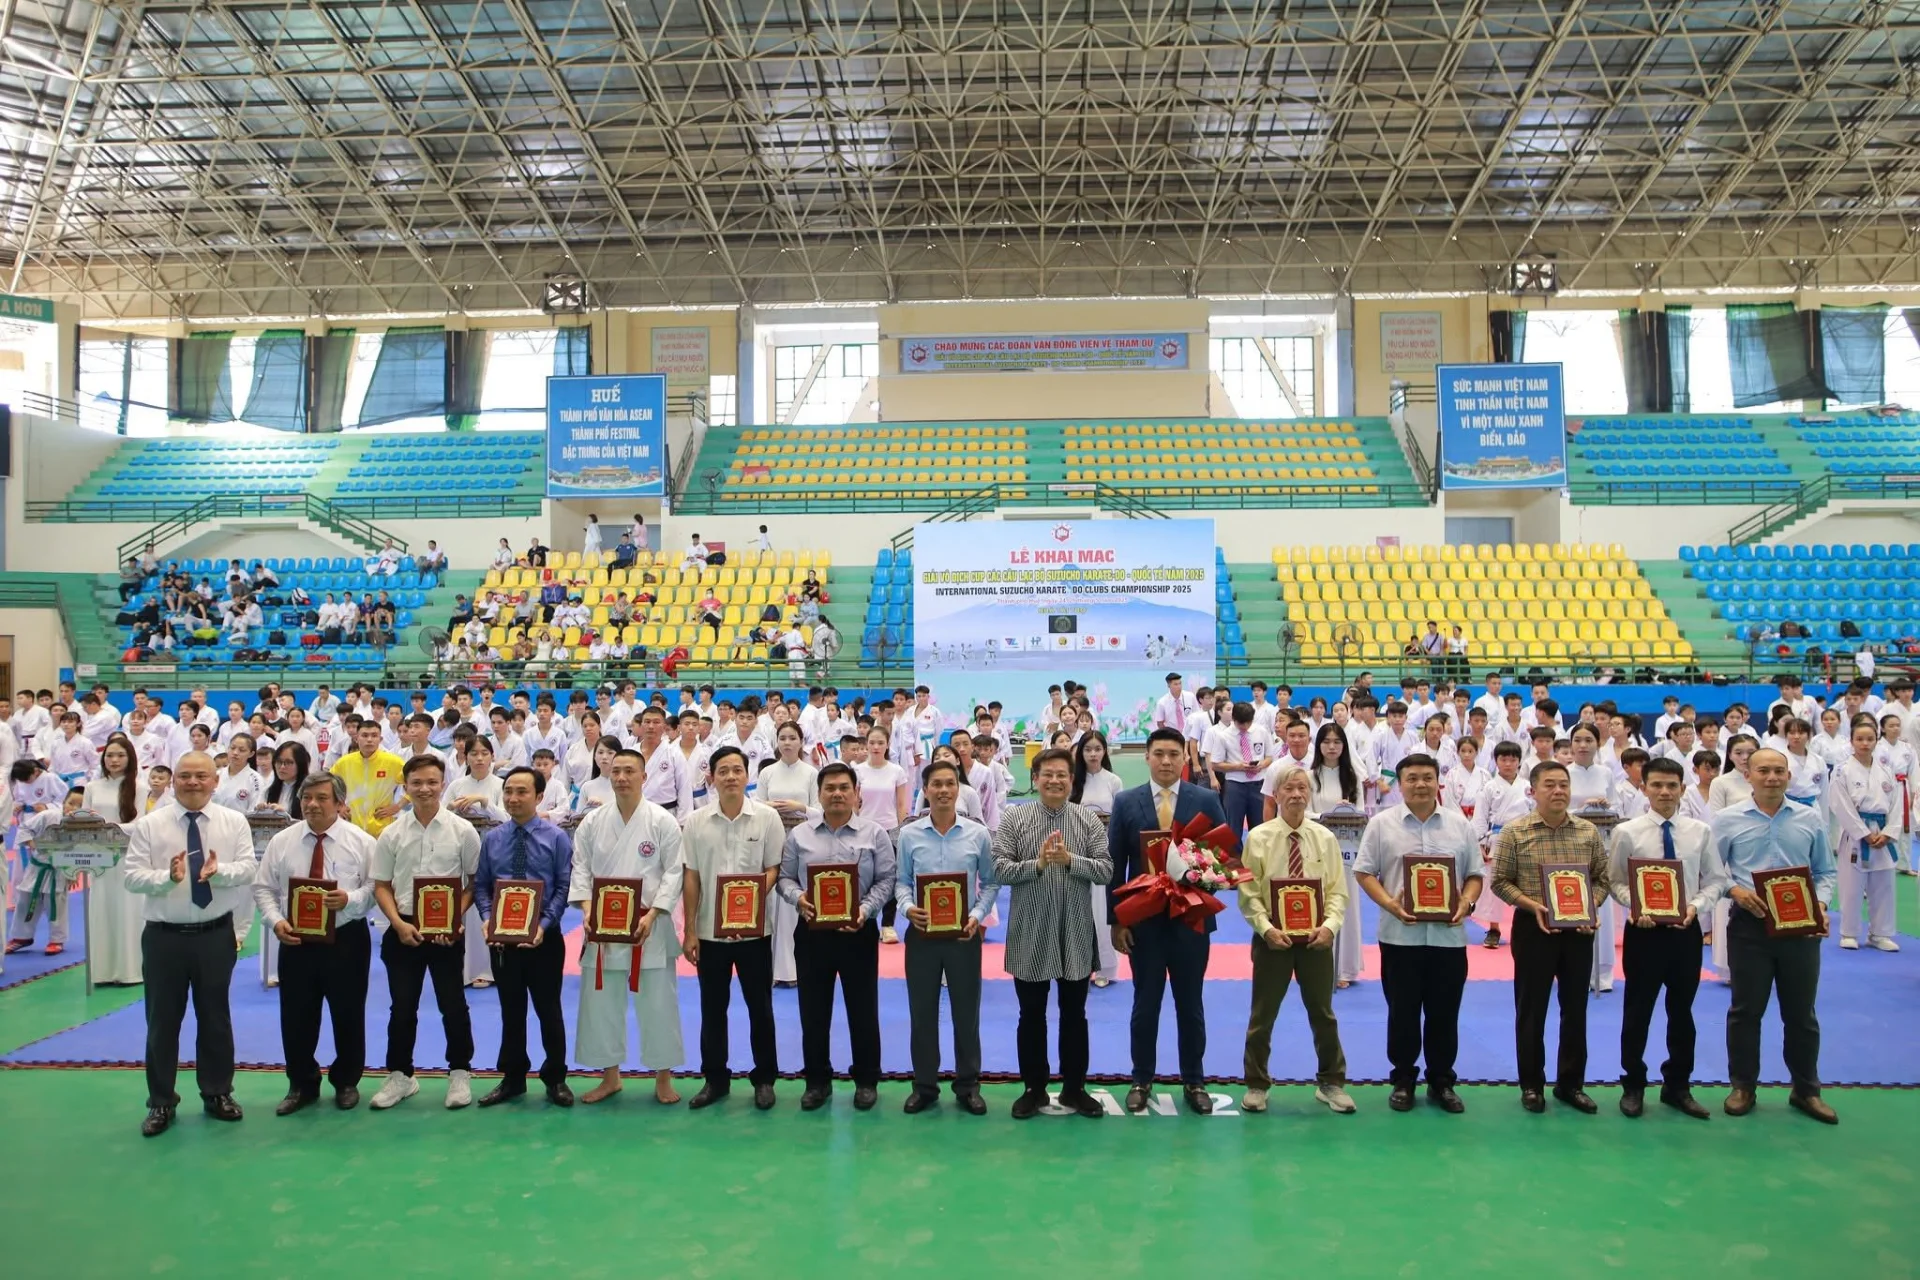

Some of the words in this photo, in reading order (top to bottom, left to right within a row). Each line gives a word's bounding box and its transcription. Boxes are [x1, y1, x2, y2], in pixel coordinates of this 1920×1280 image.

[591, 383, 620, 403] HUẾ
[1453, 378, 1472, 393] SỨC
[1474, 379, 1502, 395] MẠNH
[1504, 376, 1524, 394] VIỆT
[1526, 378, 1549, 392] NAM
[1454, 398, 1476, 411] TINH
[1504, 394, 1524, 412] VIỆT
[1526, 396, 1549, 409] NAM
[560, 408, 582, 423] THÀNH
[583, 405, 598, 422] PHỐ
[599, 407, 613, 422] VĂN
[629, 408, 653, 421] ASEAN
[1472, 414, 1492, 431] MỘT
[1494, 413, 1516, 428] MÀU
[1518, 414, 1544, 427] XANH
[571, 426, 594, 441] THÀNH
[595, 424, 609, 440] PHỐ
[610, 427, 641, 440] FESTIVAL
[578, 446, 600, 459] TRUNG
[601, 443, 616, 458] CỦA
[617, 443, 631, 460] VIỆT
[632, 445, 650, 458] NAM
[1034, 550, 1073, 564] KHAI
[970, 570, 986, 583] CUP
[986, 566, 1001, 583] CÁC
[1002, 567, 1018, 582] CÂU
[1034, 567, 1046, 584] BỘ
[1046, 569, 1081, 582] SUZUCHO
[1082, 568, 1126, 582] KARATE-DO
[1131, 564, 1152, 583] QUỐC
[1153, 563, 1164, 581] TẾ
[1164, 565, 1185, 581] NĂM
[1185, 567, 1205, 581] 2025
[935, 586, 998, 596] INTERNATIONAL
[999, 585, 1034, 595] SUZUCHO
[1036, 585, 1067, 595] KARATE
[1072, 585, 1083, 594] DO
[1085, 585, 1109, 594] CLUBS
[1111, 585, 1171, 594] CHAMPIONSHIP
[1172, 585, 1192, 594] 2025
[1208, 1093, 1240, 1116] 2
